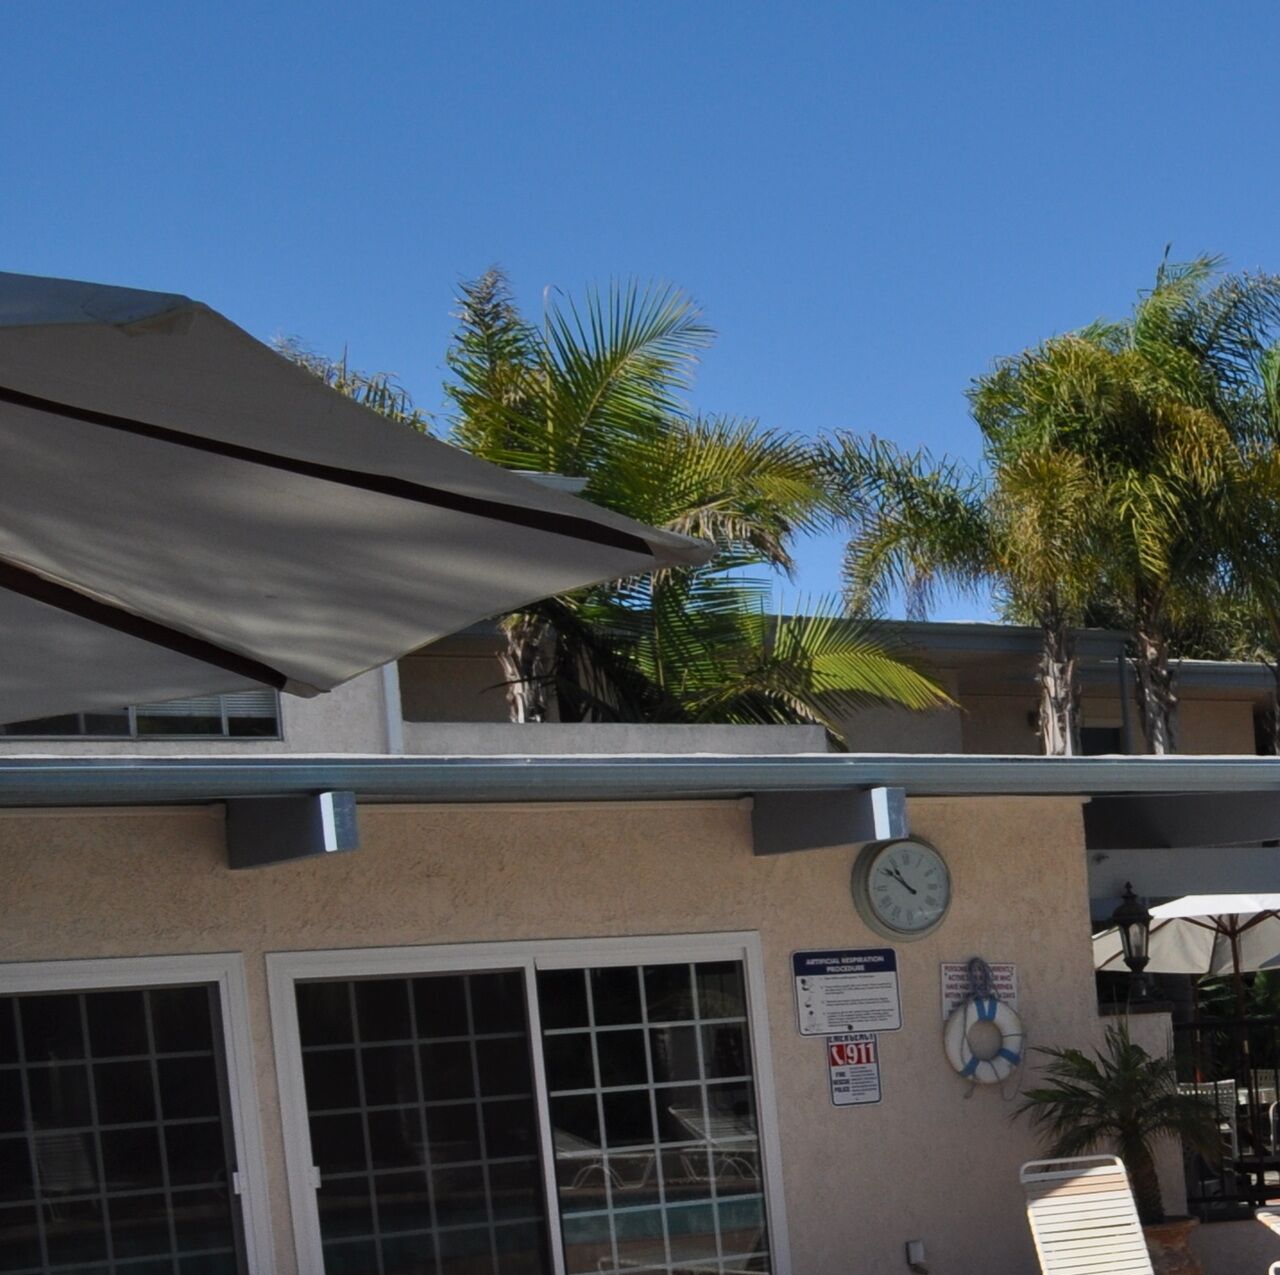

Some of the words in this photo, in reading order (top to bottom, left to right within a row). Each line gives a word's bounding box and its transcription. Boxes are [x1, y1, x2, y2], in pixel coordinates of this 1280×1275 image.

[806, 957, 839, 965] ARTIFICIAL
[841, 955, 885, 964] RESPIRATION
[826, 964, 864, 972] PROCEDURE
[846, 1043, 875, 1064] 911
